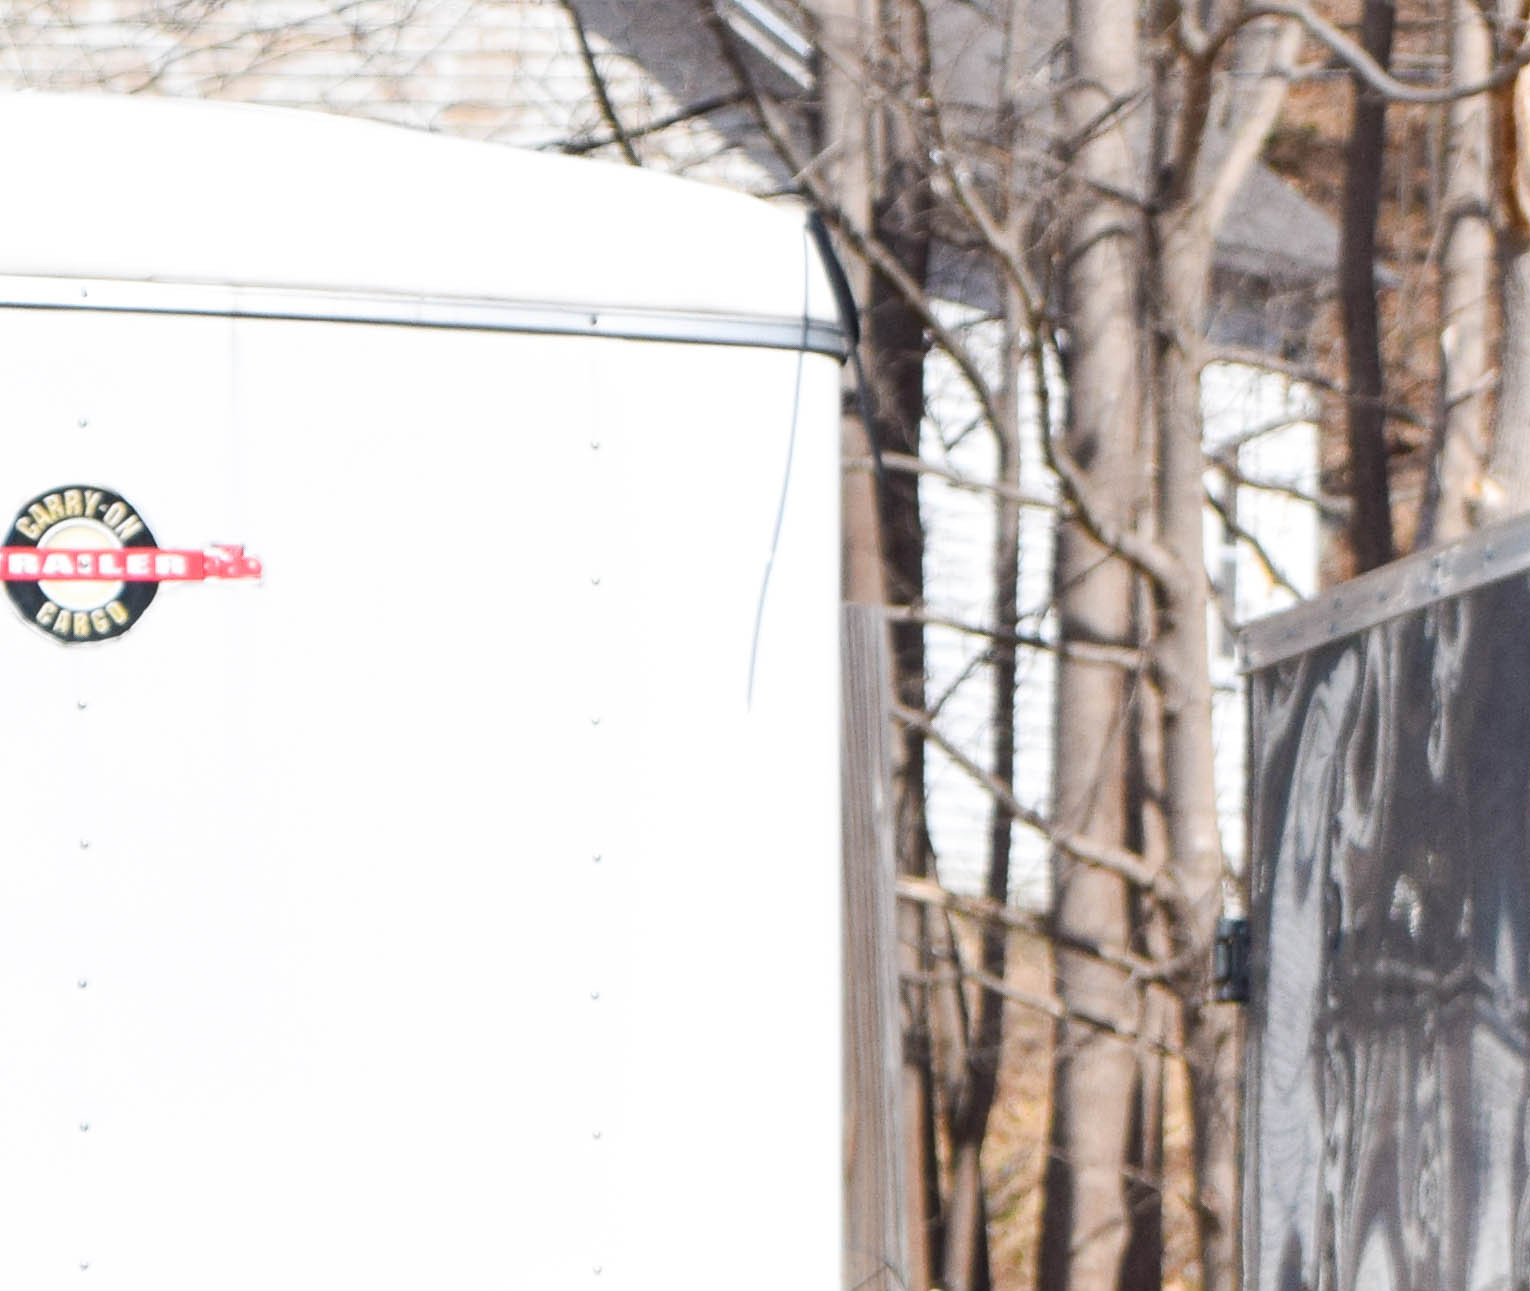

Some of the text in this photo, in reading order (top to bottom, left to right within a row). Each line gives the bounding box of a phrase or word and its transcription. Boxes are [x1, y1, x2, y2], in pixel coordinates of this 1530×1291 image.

[15, 488, 143, 541] CARRY-ON
[0, 552, 187, 576] RAILER
[36, 600, 129, 636] CARGO
